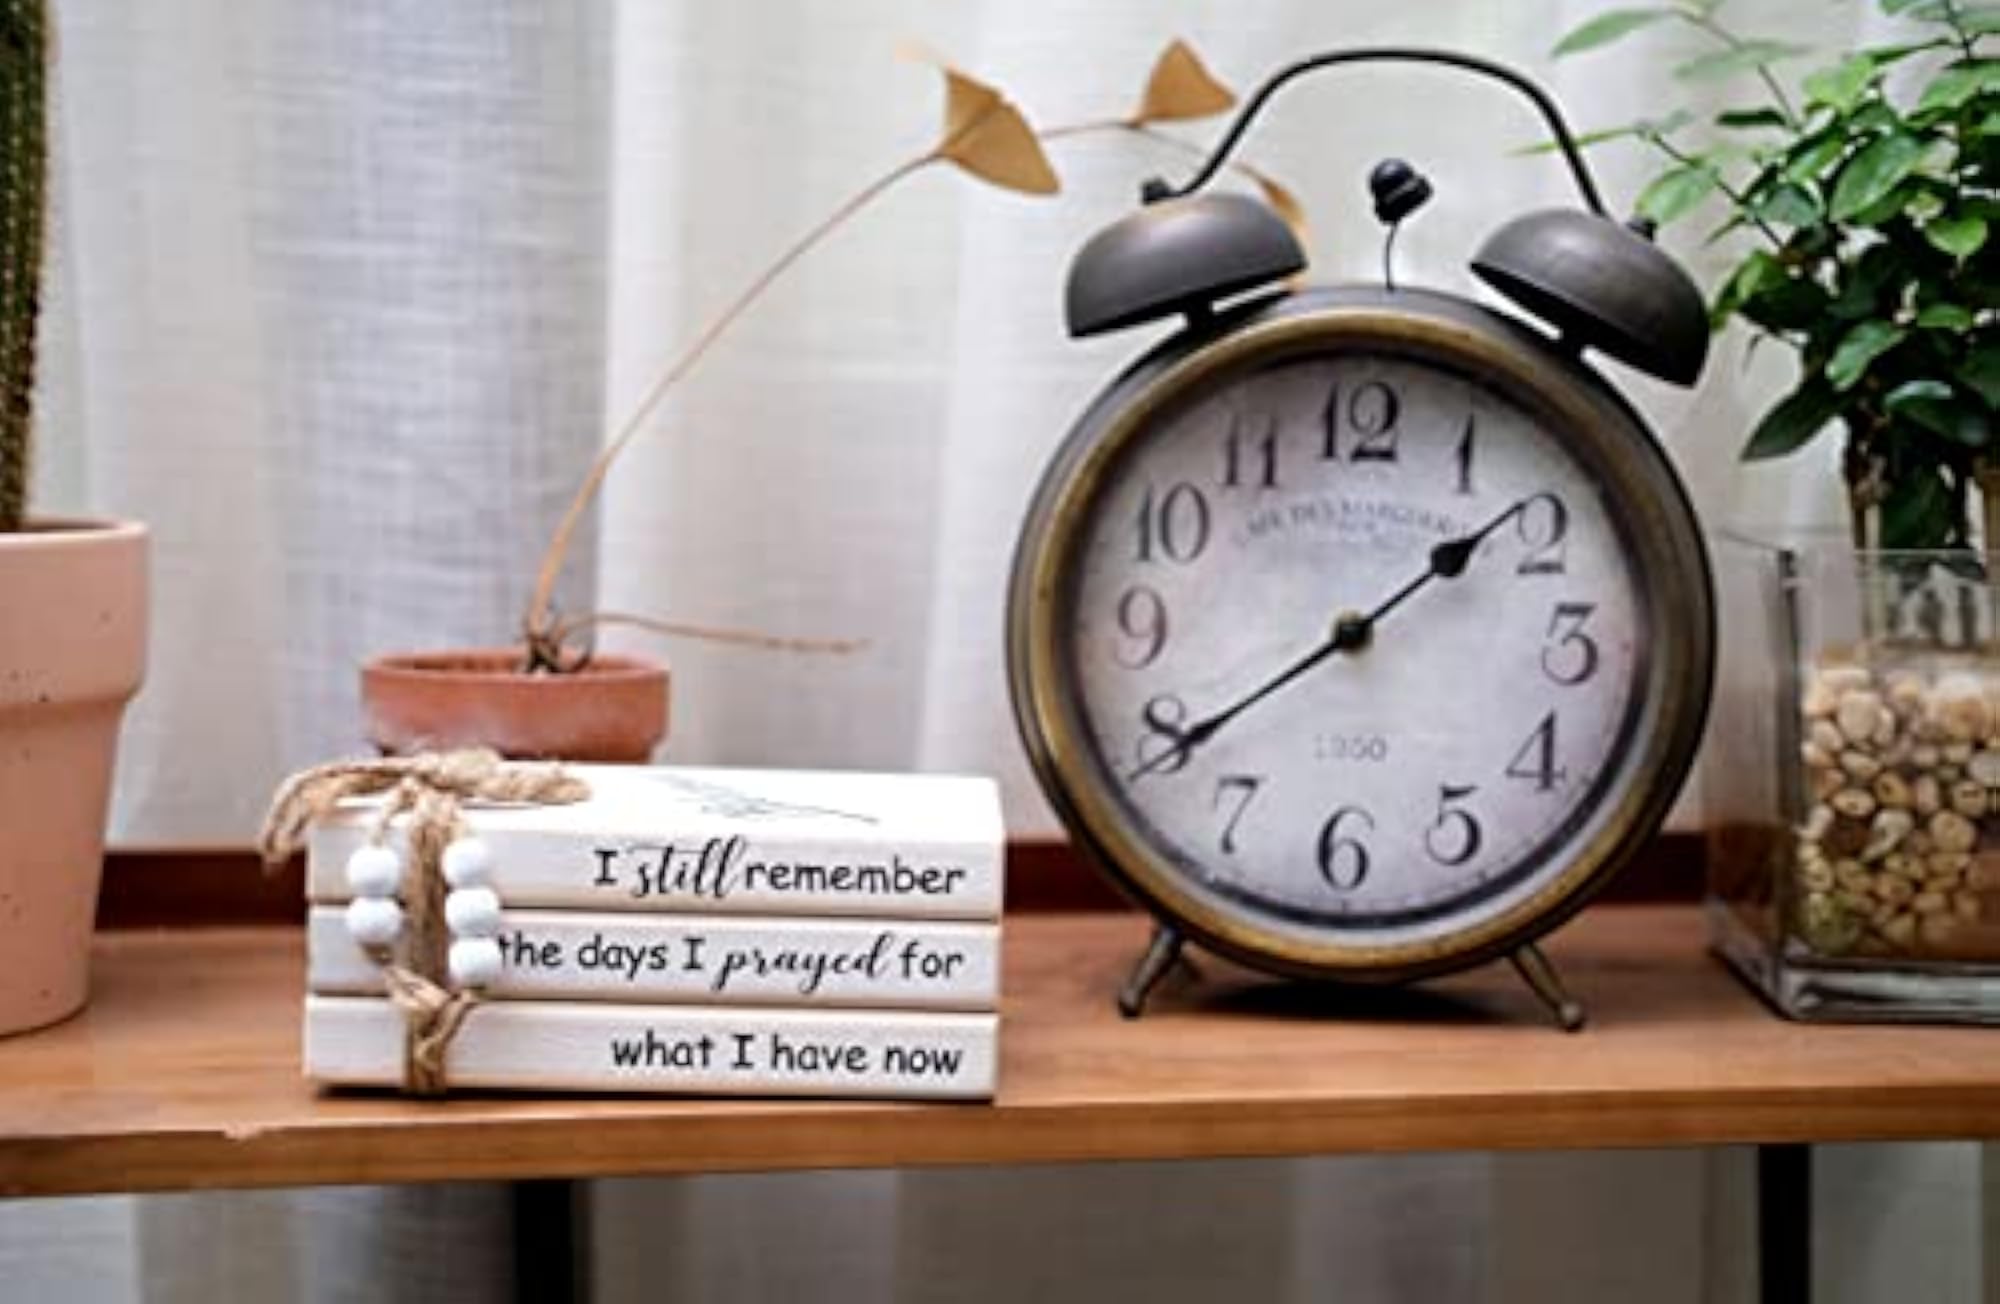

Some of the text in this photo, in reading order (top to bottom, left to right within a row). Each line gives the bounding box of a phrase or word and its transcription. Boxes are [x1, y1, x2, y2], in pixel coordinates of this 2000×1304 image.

[1223, 413, 1279, 489] 11
[1321, 381, 1399, 463] 12
[1453, 413, 1476, 493] 1
[1132, 481, 1211, 563] 10
[1514, 493, 1568, 575] 2
[1115, 584, 1168, 670] 9
[1541, 603, 1599, 685] 3
[1137, 694, 1194, 774] 8
[1505, 709, 1568, 792] 4
[1214, 775, 1261, 854] 7
[1316, 806, 1376, 891] 6
[1425, 784, 1482, 866] 5
[594, 834, 966, 898] I still remember
[498, 929, 965, 992] the days I prayed for
[611, 1027, 963, 1075] what I have now
